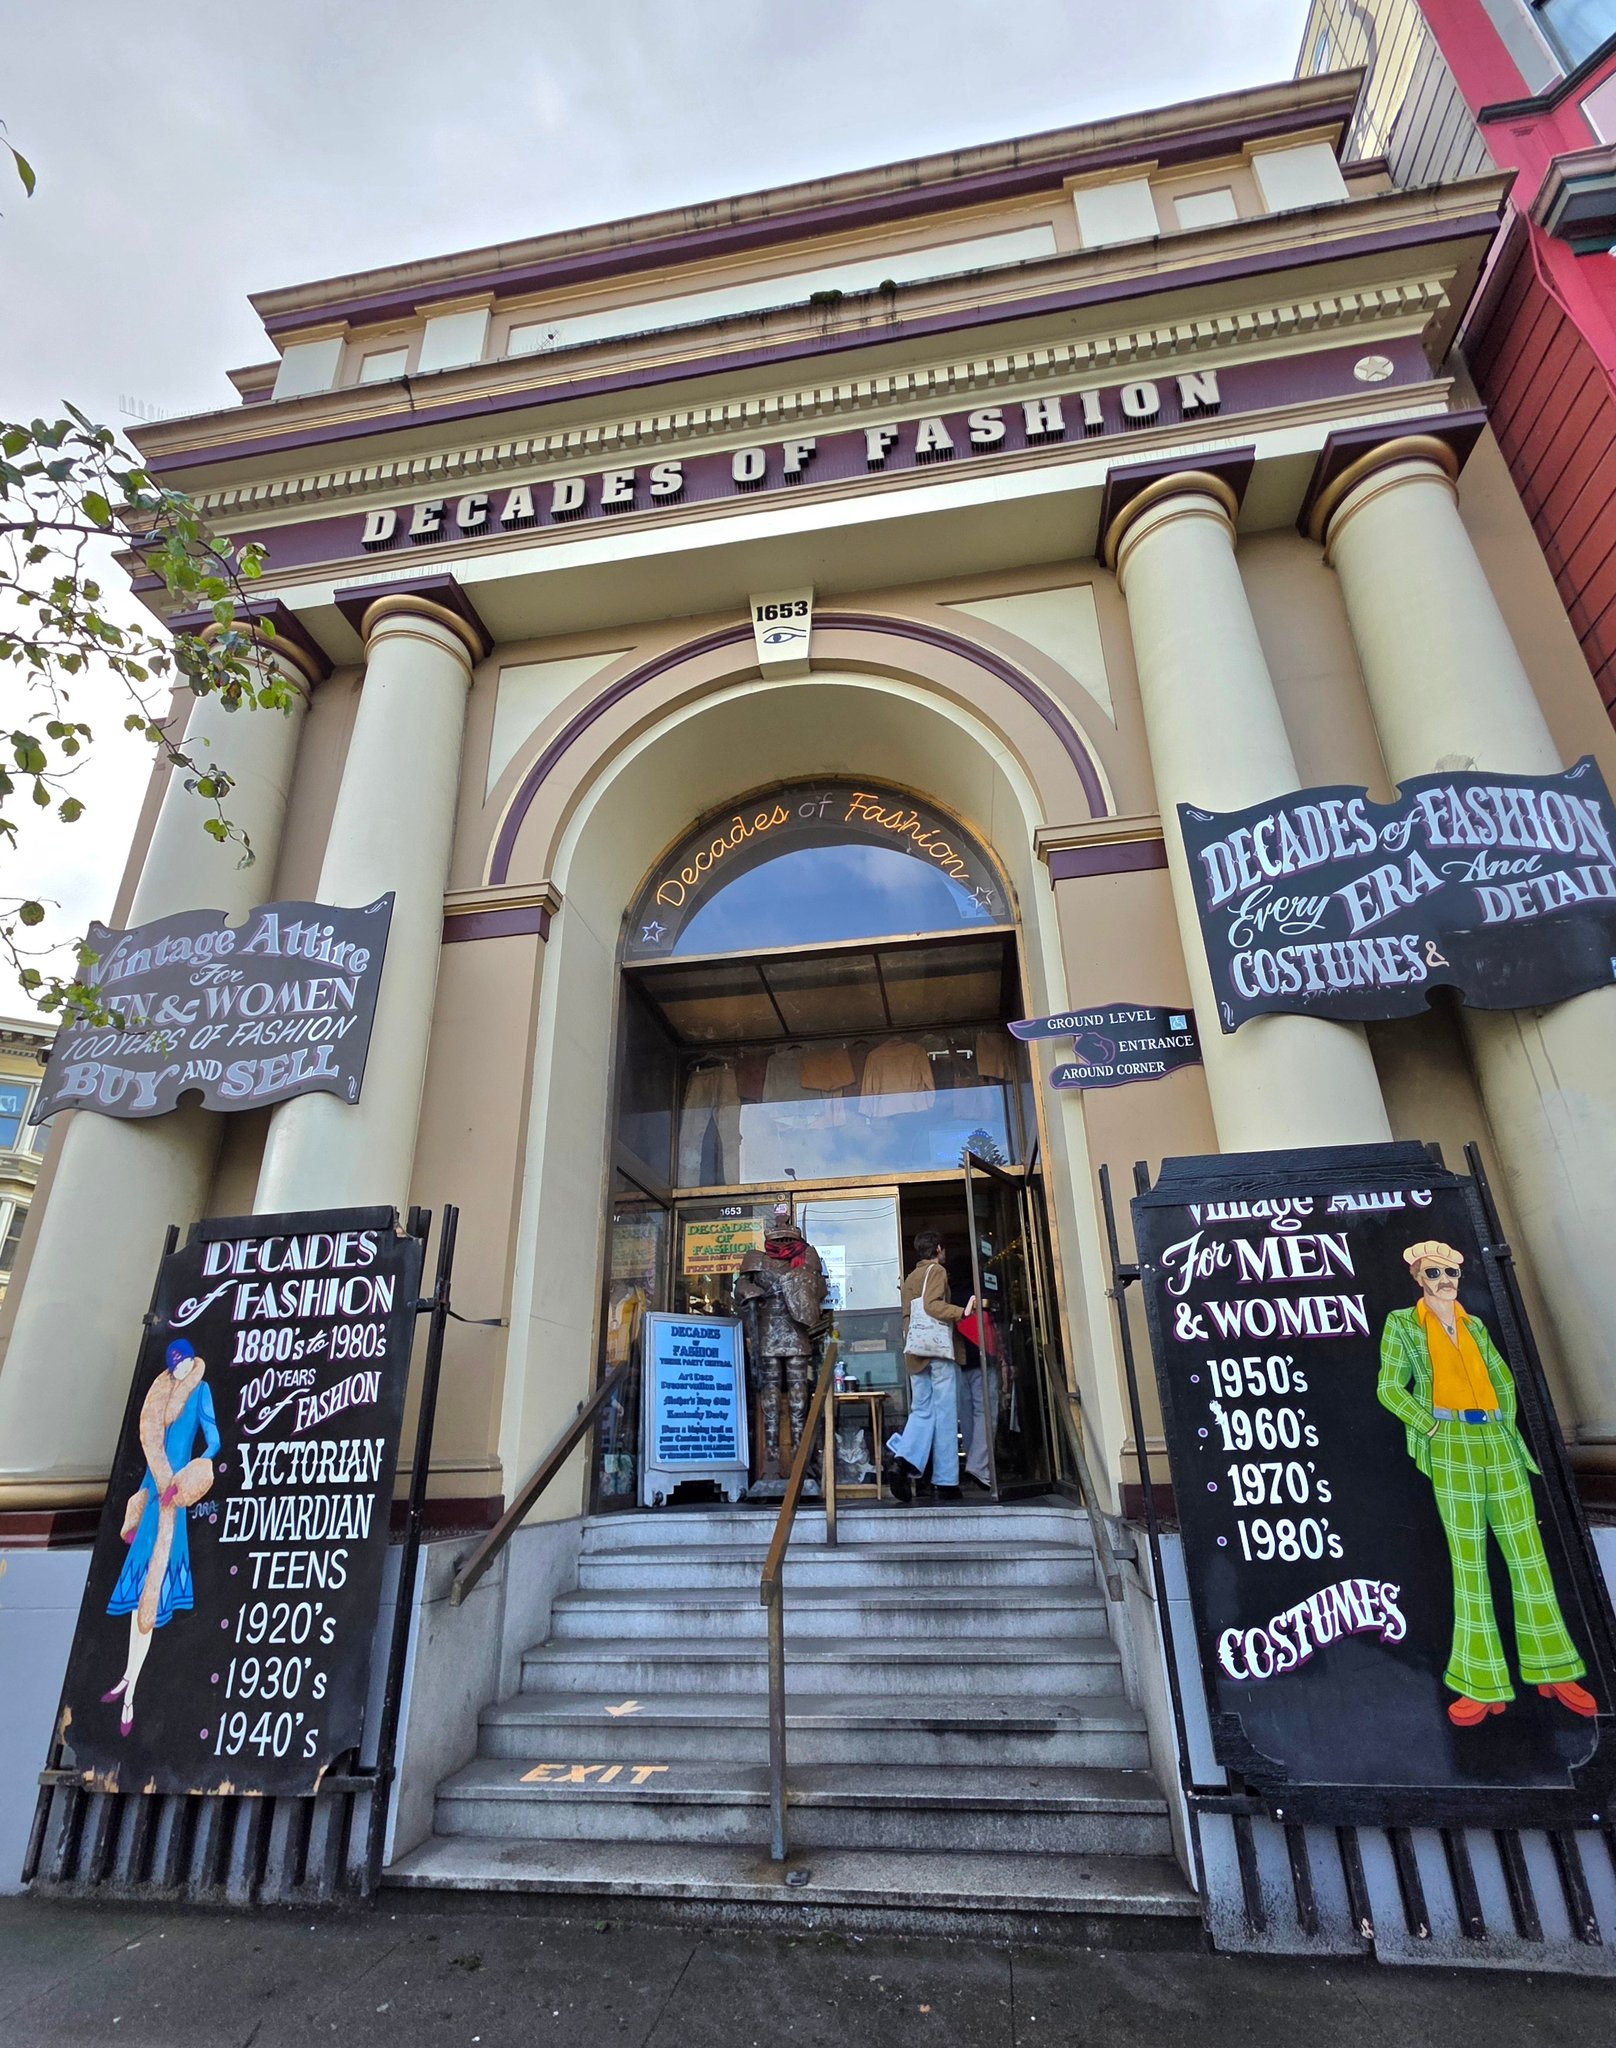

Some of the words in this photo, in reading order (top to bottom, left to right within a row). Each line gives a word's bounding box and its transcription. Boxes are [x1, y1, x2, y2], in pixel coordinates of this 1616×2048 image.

[361, 462, 685, 545] DECADES
[731, 438, 817, 484] OF
[864, 370, 1221, 462] FASHION
[756, 600, 808, 622] 1653
[656, 804, 790, 907] Decades
[798, 792, 833, 819] of
[843, 792, 971, 881] Fashion
[1200, 798, 1378, 906] DECADES
[1378, 805, 1423, 852] of
[1416, 784, 1616, 867] FASHION
[1227, 884, 1331, 948] Every
[1334, 849, 1447, 936] ERA
[1440, 849, 1543, 883] And
[244, 912, 370, 974] Attire
[190, 963, 245, 987] For
[1231, 934, 1428, 998] COSTUMES
[1425, 940, 1450, 968] &
[155, 994, 200, 1026] &
[204, 976, 361, 1019] WOMEN
[1047, 1014, 1104, 1030] GROUND
[1109, 1010, 1156, 1025] LEVEL
[189, 1024, 224, 1050] OF
[227, 1015, 358, 1048] FASHION
[1118, 1034, 1194, 1053] ENTRANCE
[57, 1061, 181, 1108] BUY
[179, 1060, 223, 1086] AND
[220, 1045, 340, 1097] SELL
[1061, 1065, 1114, 1080] AROUND
[1116, 1061, 1166, 1077] CORNER
[687, 1222, 763, 1236] DECADES
[692, 1242, 757, 1256] FASHION
[715, 1234, 735, 1244] OF
[202, 1229, 378, 1276] DECADES
[1161, 1230, 1233, 1297] For
[1232, 1232, 1357, 1284] MEN
[168, 1279, 238, 1328] of
[232, 1274, 396, 1321] FASHION
[1174, 1301, 1209, 1341] &
[1204, 1293, 1371, 1340] WOMEN
[233, 1327, 305, 1365] 1880's
[304, 1330, 330, 1354] to
[329, 1322, 387, 1361] 1980's
[671, 1326, 721, 1340] DECADES
[672, 1345, 719, 1358] FASHION
[236, 1366, 276, 1421] 100
[275, 1368, 317, 1388] YEARS
[1206, 1355, 1309, 1399] 1950's
[242, 1387, 311, 1435] of
[293, 1370, 382, 1434] FASHION
[1215, 1408, 1320, 1451] 1960's
[236, 1437, 385, 1491] VICTORIAN
[1227, 1461, 1332, 1507] 1970's
[218, 1494, 376, 1543] EDWARDIAN
[1237, 1517, 1345, 1562] 1980's
[248, 1548, 349, 1590] TEENS
[234, 1602, 337, 1645] 1920's
[1217, 1578, 1408, 1680] COSTUMES
[224, 1656, 328, 1700] 1930's
[213, 1711, 319, 1758] 1940's
[519, 1763, 670, 1785] EXIT
